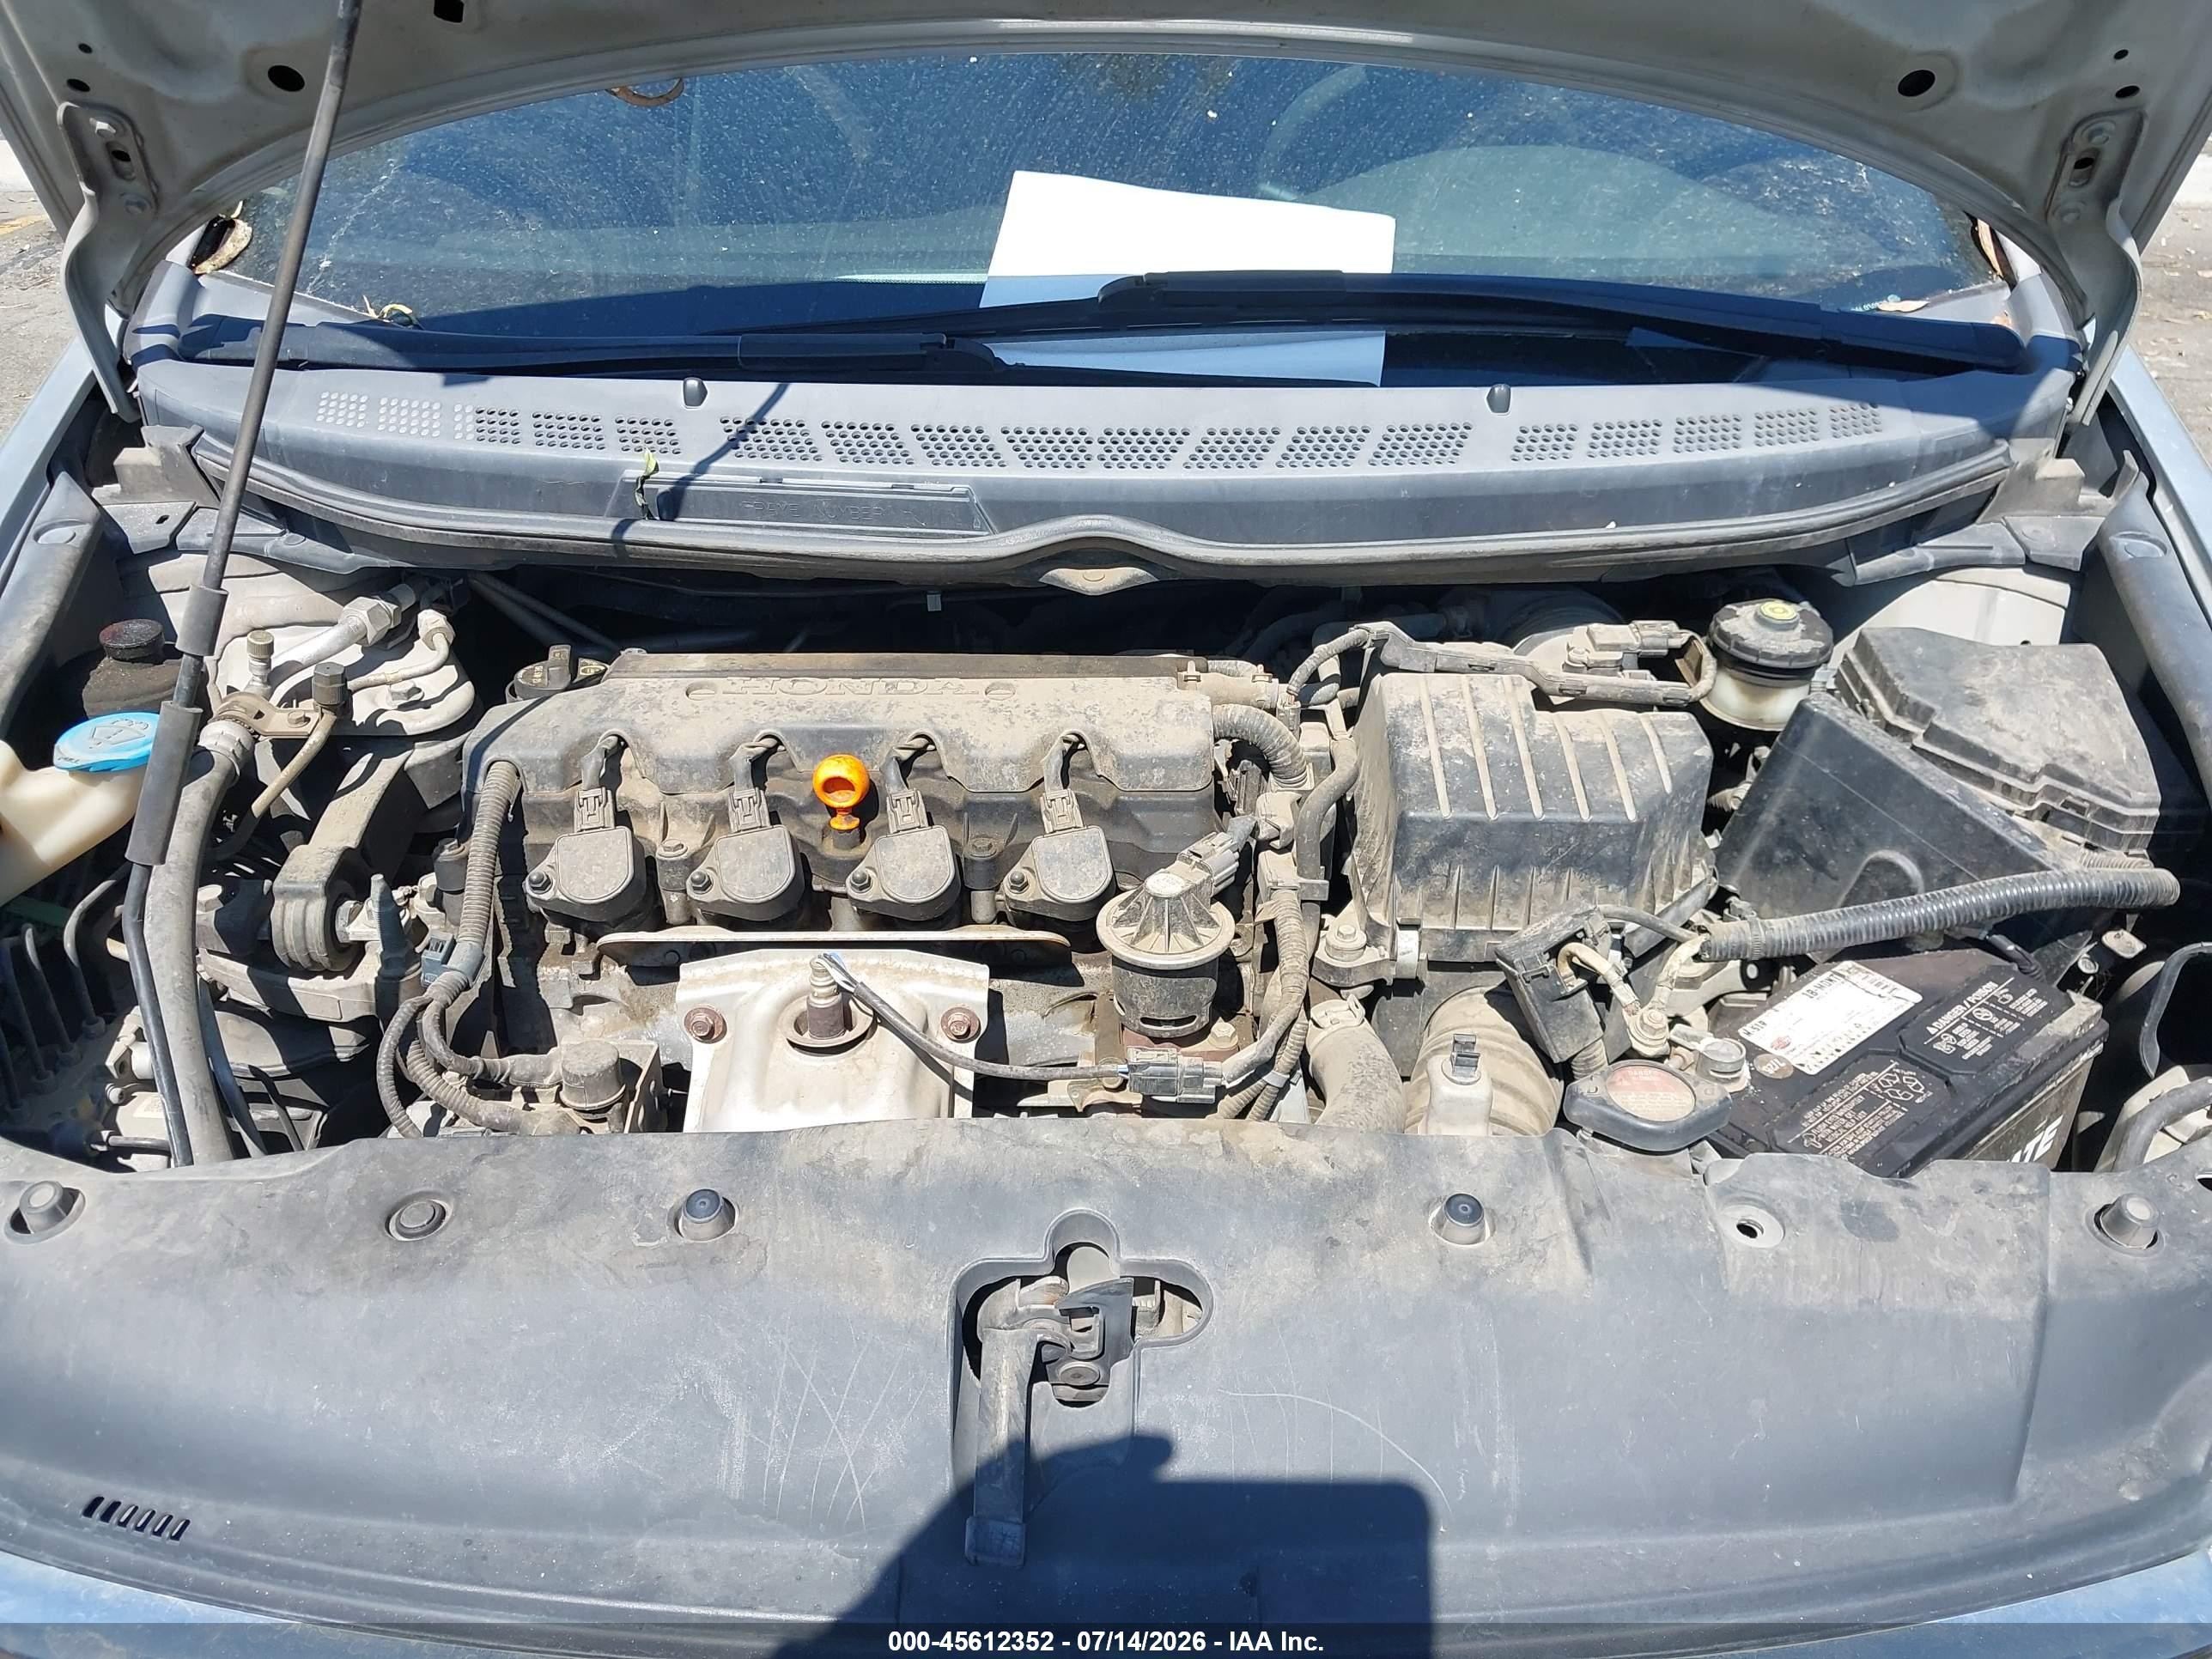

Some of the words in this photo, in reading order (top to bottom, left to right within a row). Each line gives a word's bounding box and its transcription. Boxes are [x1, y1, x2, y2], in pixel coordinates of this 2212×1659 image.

[722, 677, 980, 696] HONDA
[1932, 1005, 1967, 1030] DANGER
[1966, 981, 1999, 1004] POISON
